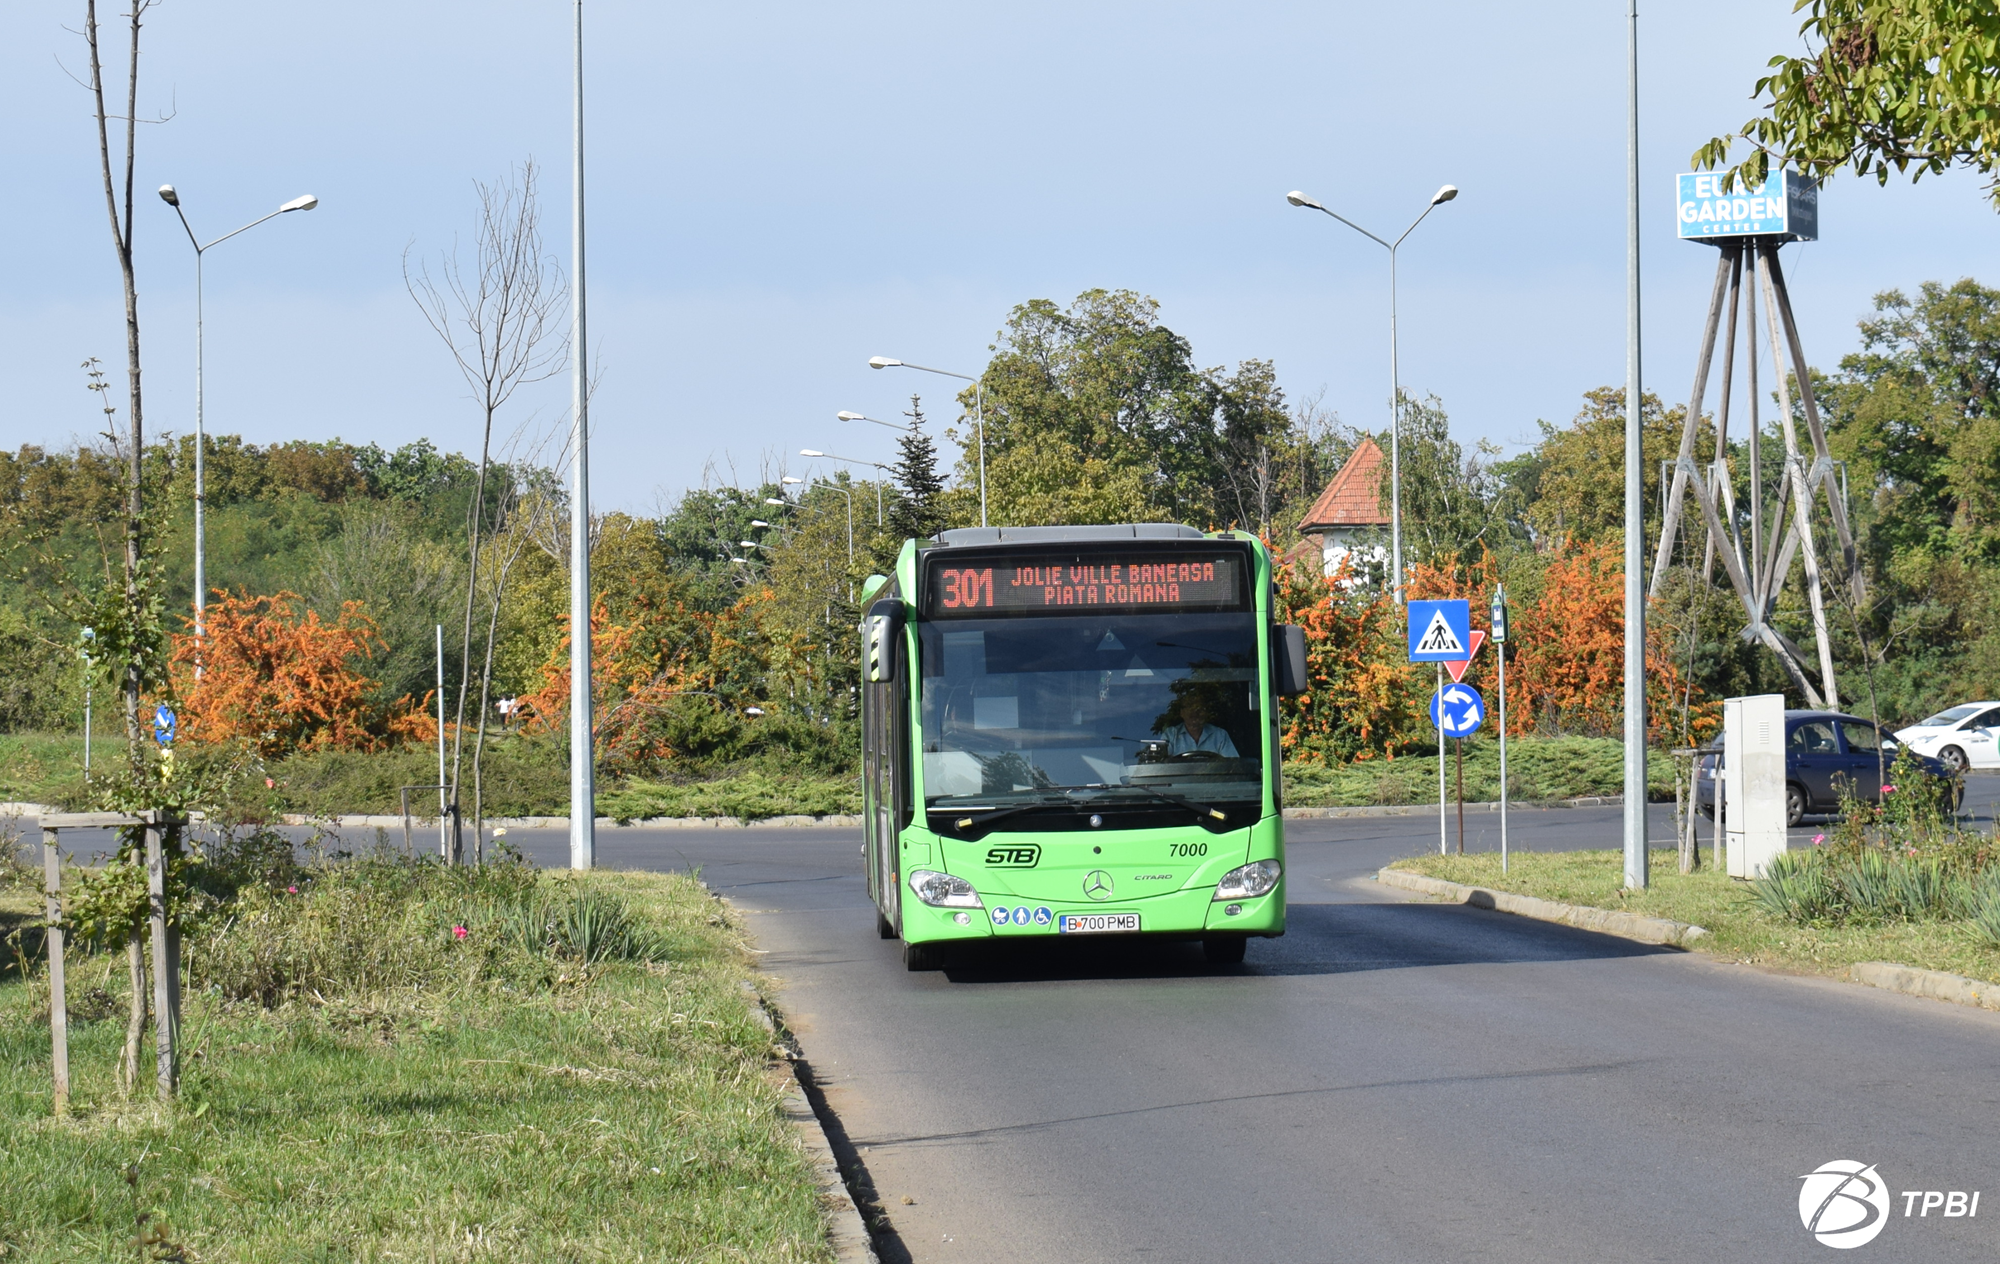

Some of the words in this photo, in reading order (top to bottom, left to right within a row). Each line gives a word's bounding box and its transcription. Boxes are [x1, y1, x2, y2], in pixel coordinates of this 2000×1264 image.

[1680, 197, 1783, 223] GARDEN
[1703, 223, 1761, 233] CENTER
[1011, 566, 1062, 586] JOLIE
[1070, 565, 1121, 584] VILLE
[1129, 562, 1214, 583] BANEASA
[943, 568, 993, 607] 301
[1044, 585, 1098, 605] PIATA
[1105, 583, 1180, 603] ROMANA
[984, 848, 1036, 864] STB
[1169, 843, 1208, 857] 7000
[1068, 918, 1078, 930] B
[1081, 917, 1105, 930] 700
[1107, 916, 1136, 929] PMB
